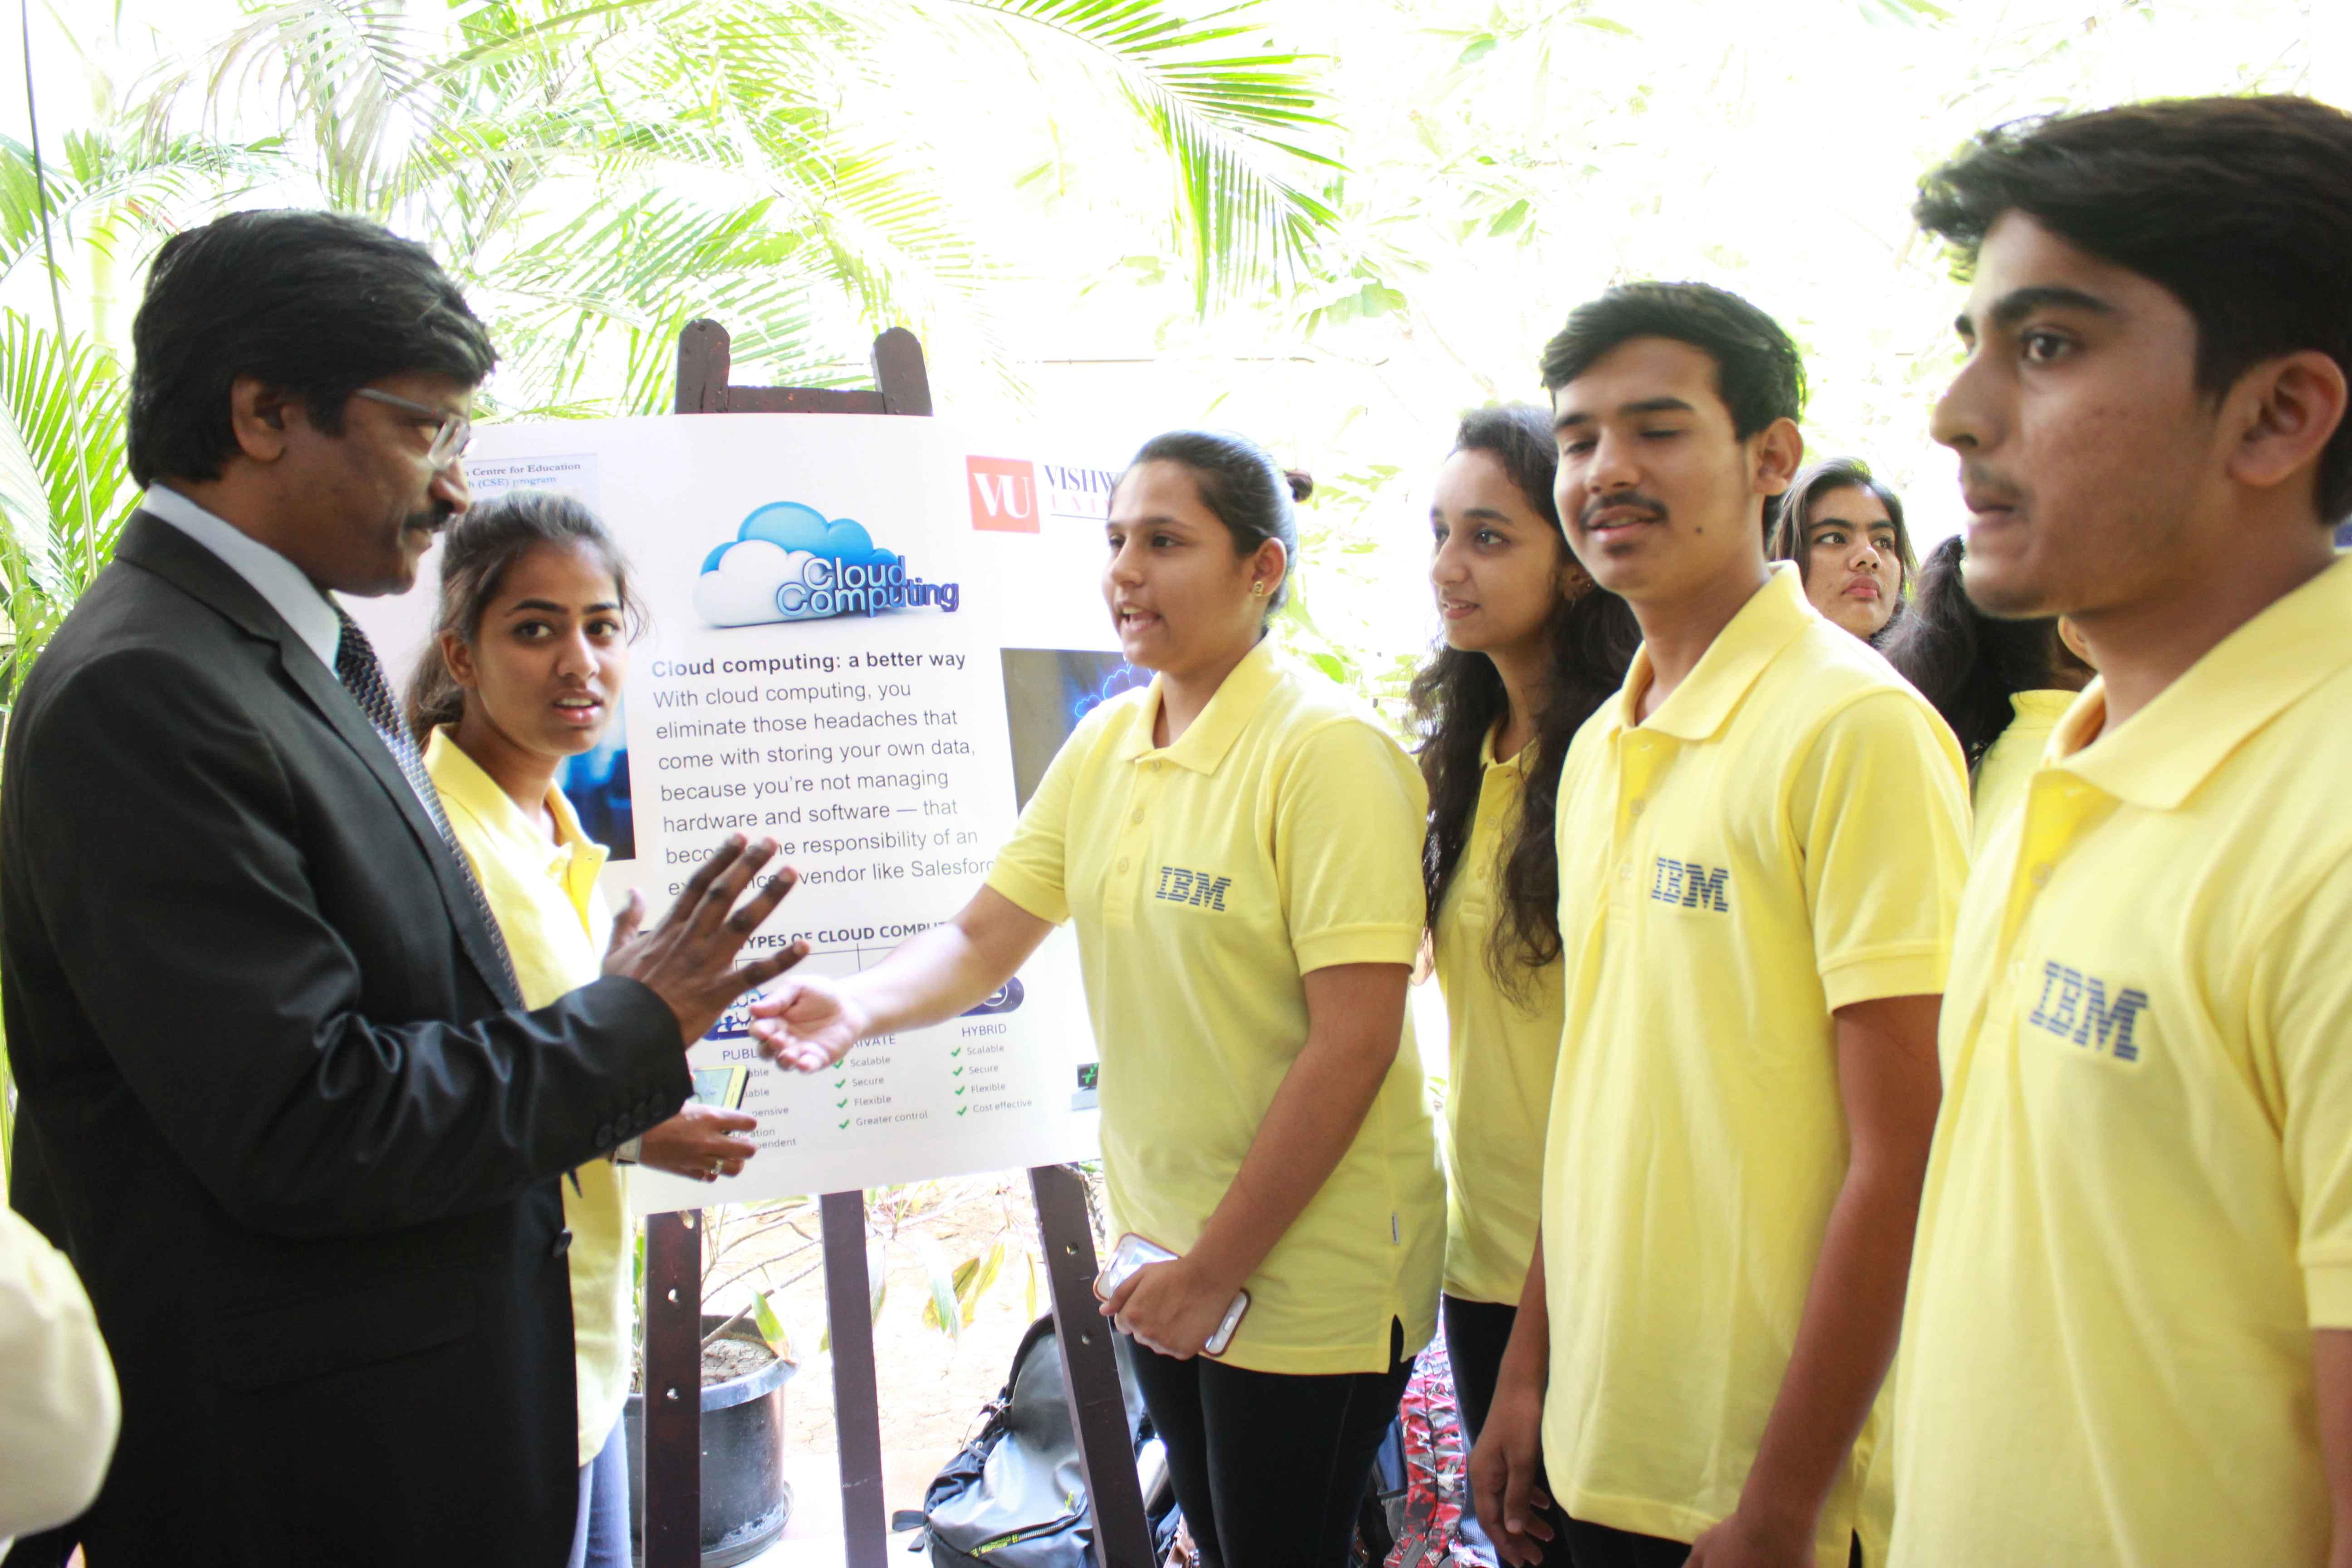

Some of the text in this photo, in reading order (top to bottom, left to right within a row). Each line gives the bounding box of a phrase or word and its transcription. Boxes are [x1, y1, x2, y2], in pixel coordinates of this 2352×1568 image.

[472, 467, 506, 476] Centre
[510, 466, 524, 474] for
[527, 463, 581, 472] Education
[478, 478, 509, 489] (CSE)
[513, 476, 557, 487] program
[972, 472, 1030, 519] VU
[803, 555, 907, 590] Cloud
[777, 578, 959, 618] Computing
[652, 652, 965, 677] Cloud computing: a better way
[653, 681, 911, 708] With cloud computing, you
[656, 709, 957, 739] eliminate those headaches that
[658, 739, 975, 770] come with storing your own data,
[661, 770, 948, 802] because you're not managing
[664, 813, 758, 833] hardware
[765, 807, 801, 825] and
[808, 804, 890, 822] software
[923, 799, 958, 816] that
[666, 848, 714, 864] beco
[803, 831, 926, 855] responsibility
[934, 828, 951, 846] of
[957, 831, 978, 844] an
[799, 866, 866, 884] vendor
[873, 862, 904, 880] like
[911, 858, 995, 877] Salesforc
[1156, 866, 1231, 911] IBM
[1651, 858, 1728, 912] IBM
[747, 934, 787, 949] YPES
[791, 932, 813, 943] OF
[818, 927, 874, 943] CLOUD
[2029, 960, 2147, 1061] IBM
[961, 1024, 1007, 1037] HYBRID
[722, 1049, 759, 1061] PUBL
[967, 1044, 1004, 1055] Scalable
[850, 1055, 891, 1067] Scalable
[969, 1064, 999, 1074] Secure
[852, 1077, 884, 1087] Secure
[971, 1083, 1006, 1094] Flexible
[752, 1106, 789, 1117] pensive
[854, 1095, 892, 1107] Flexible
[973, 1098, 1032, 1113] Cost effective
[856, 1111, 928, 1127] Greater control
[758, 1138, 796, 1149] pendent
